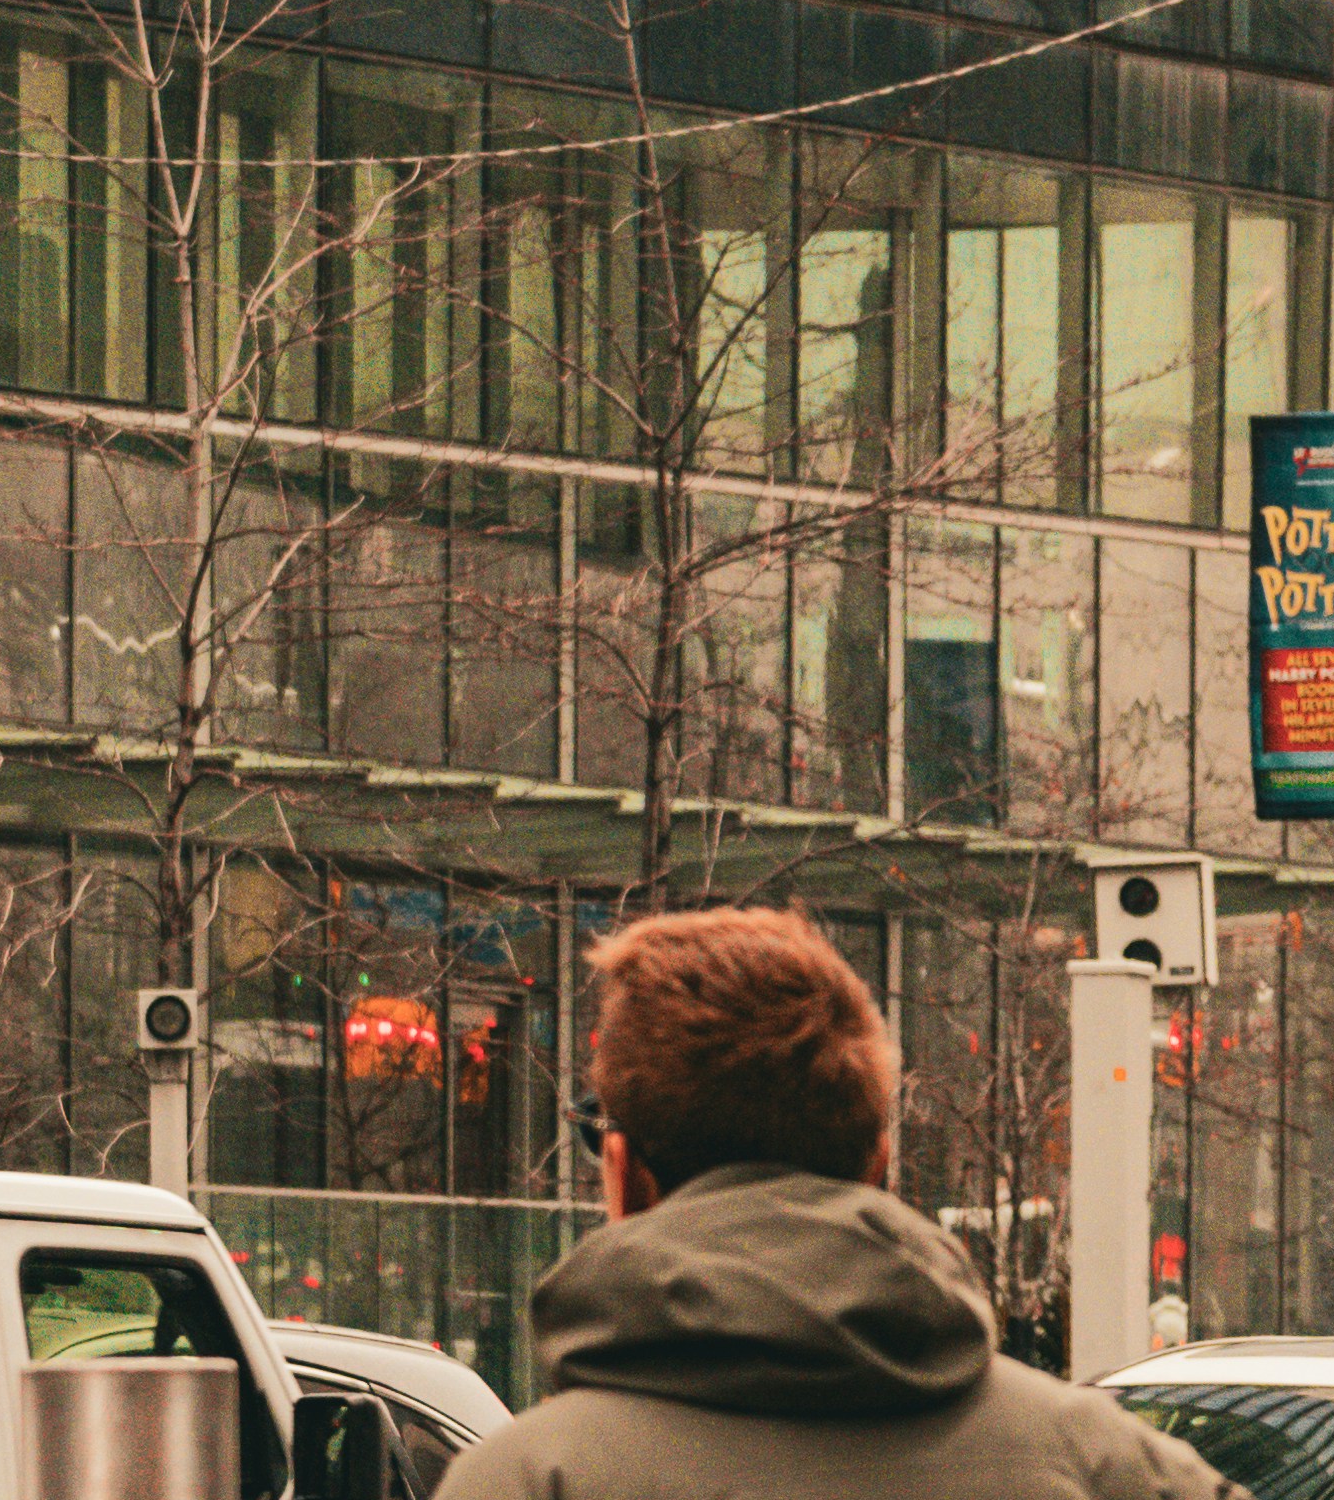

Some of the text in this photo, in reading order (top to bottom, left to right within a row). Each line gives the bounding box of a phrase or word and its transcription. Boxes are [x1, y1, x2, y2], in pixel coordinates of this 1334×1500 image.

[1286, 651, 1310, 667] ALL
[1268, 668, 1317, 683] HARRY
[1280, 699, 1299, 714] IN
